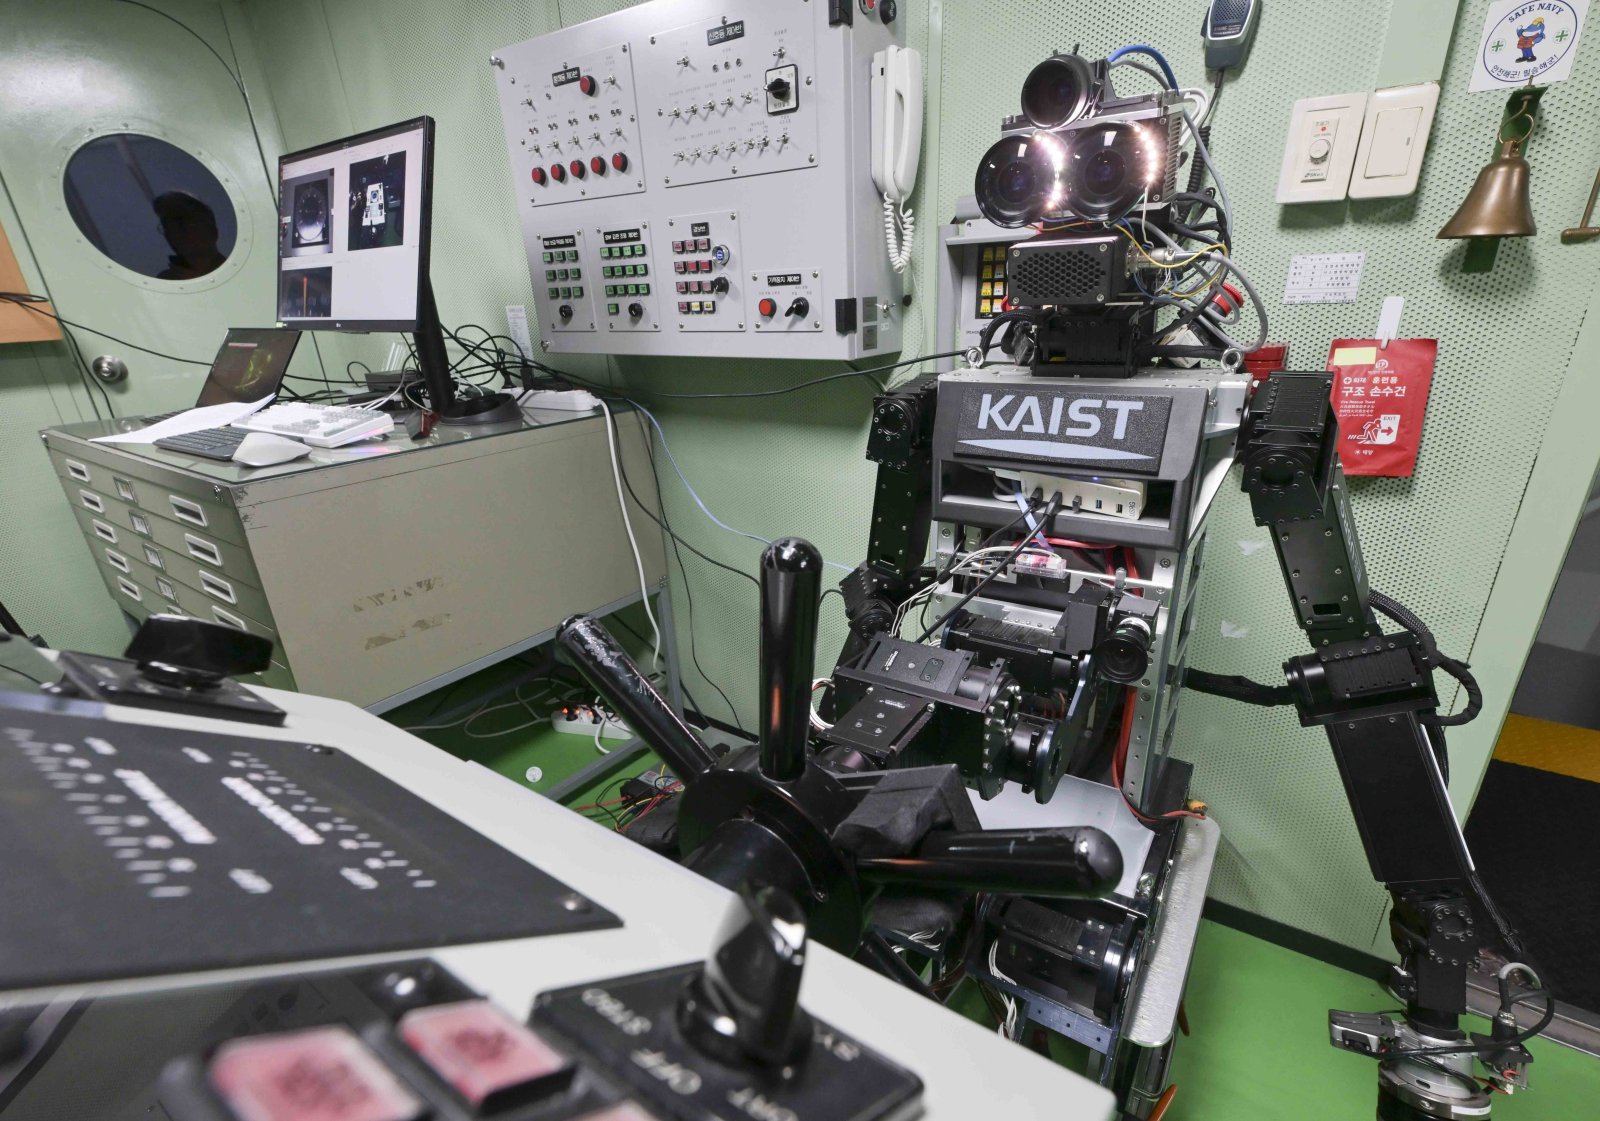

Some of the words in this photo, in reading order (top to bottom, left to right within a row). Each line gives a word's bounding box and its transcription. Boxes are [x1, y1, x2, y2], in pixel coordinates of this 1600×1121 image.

[1508, 5, 1535, 23] SAFE
[1537, 3, 1564, 15] NAVY
[1490, 64, 1520, 79] 안전해군!
[1371, 376, 1398, 384] 훈련용
[1341, 386, 1365, 397] 구조
[1369, 386, 1406, 397] 손수건
[977, 393, 1144, 440] KAIST
[630, 1048, 702, 1095] OFF
